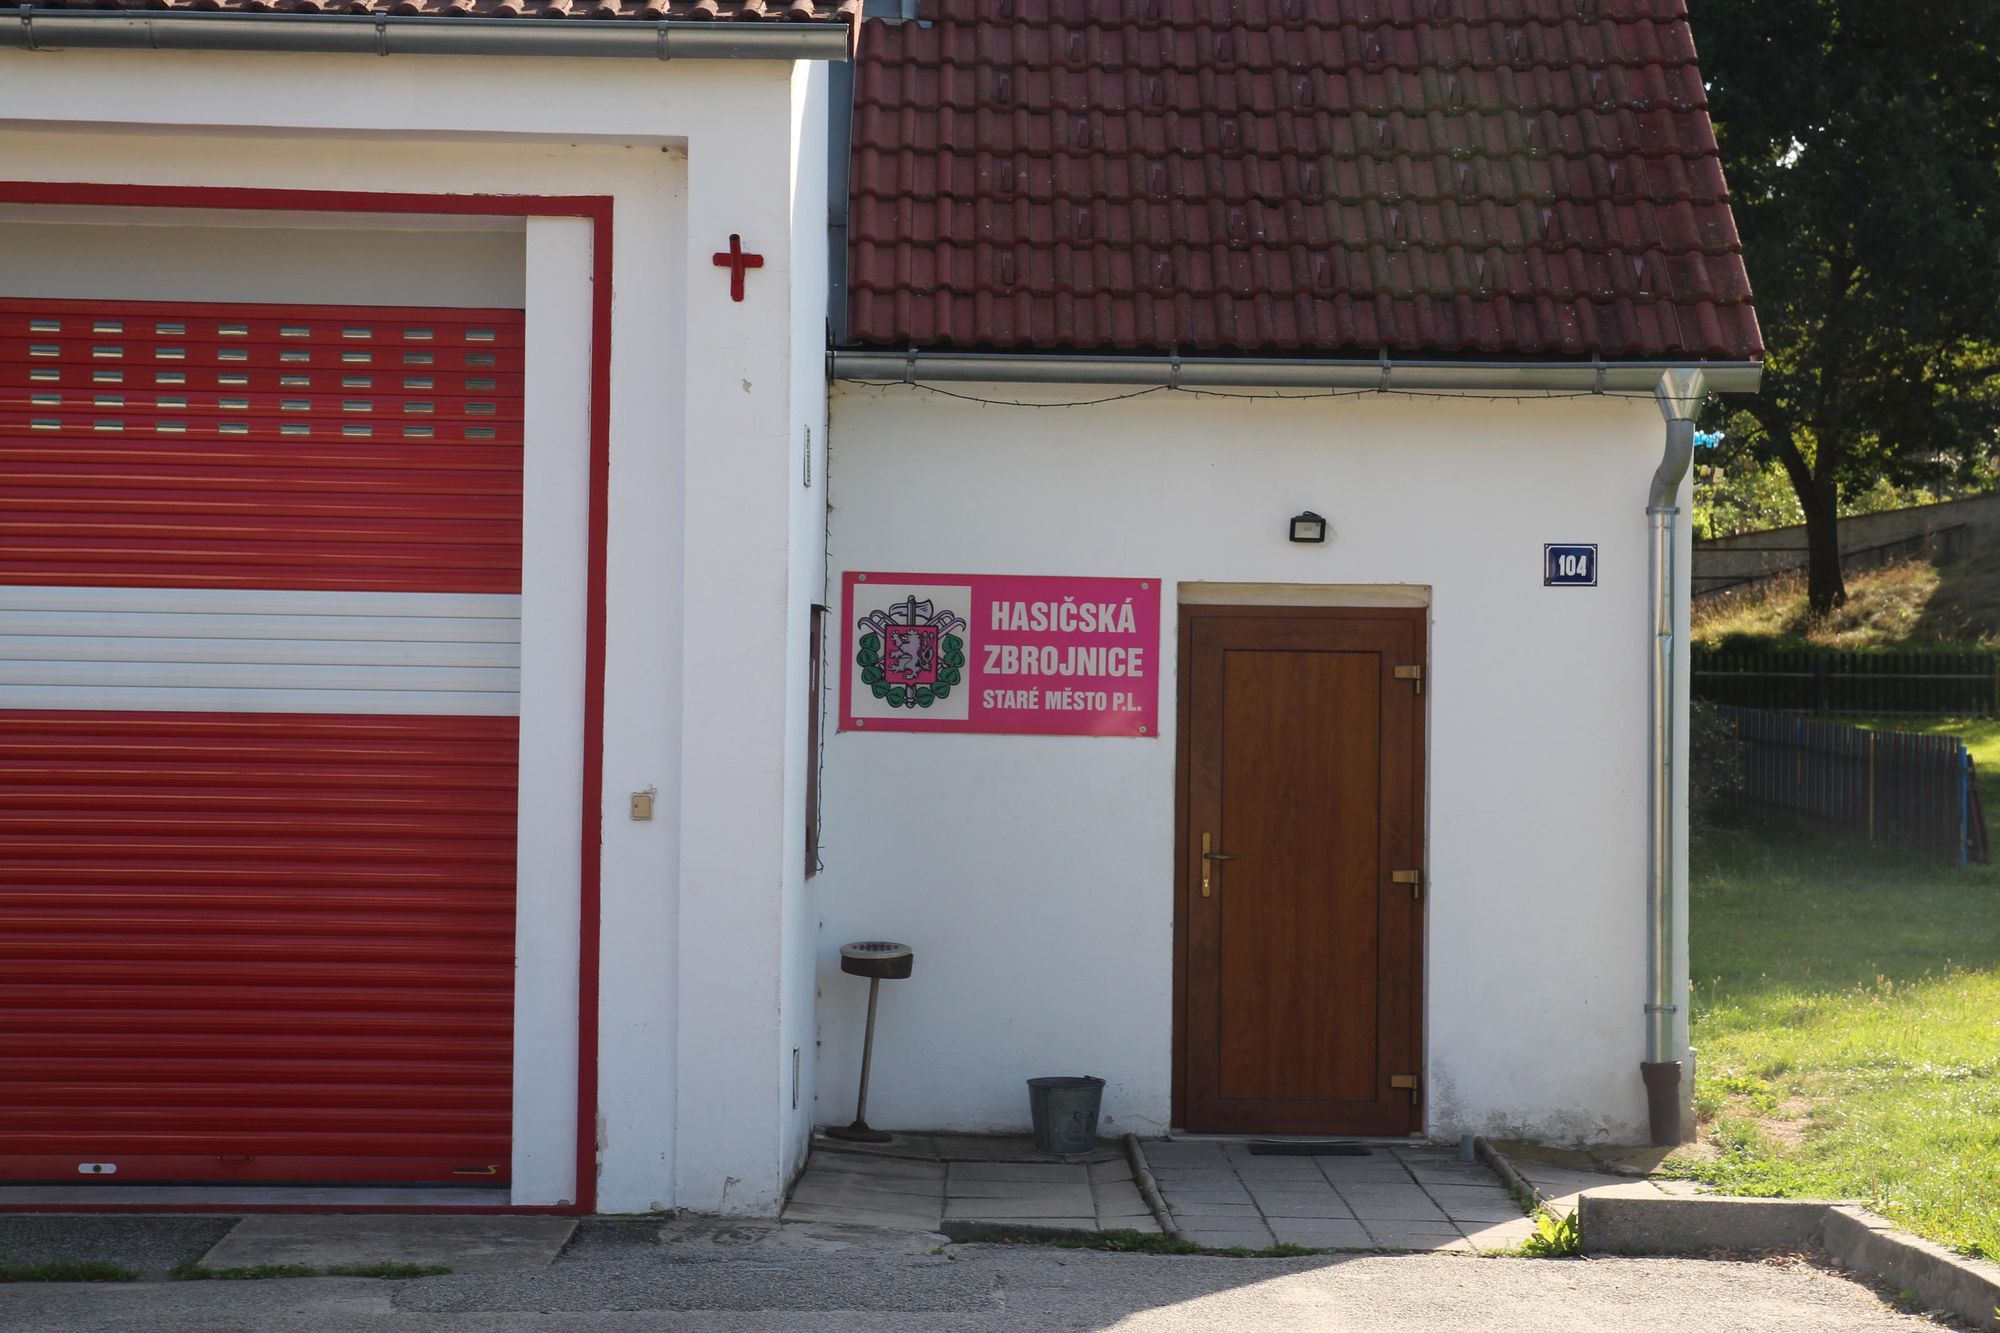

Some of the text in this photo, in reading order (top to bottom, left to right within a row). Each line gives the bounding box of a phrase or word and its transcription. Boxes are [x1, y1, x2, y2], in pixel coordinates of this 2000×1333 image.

[1558, 554, 1587, 577] 104
[991, 596, 1137, 633] HASIČSKÁ
[982, 645, 1144, 678] ZBROJNICE
[982, 687, 1142, 711] STARÉ MĚSTO P.L.
